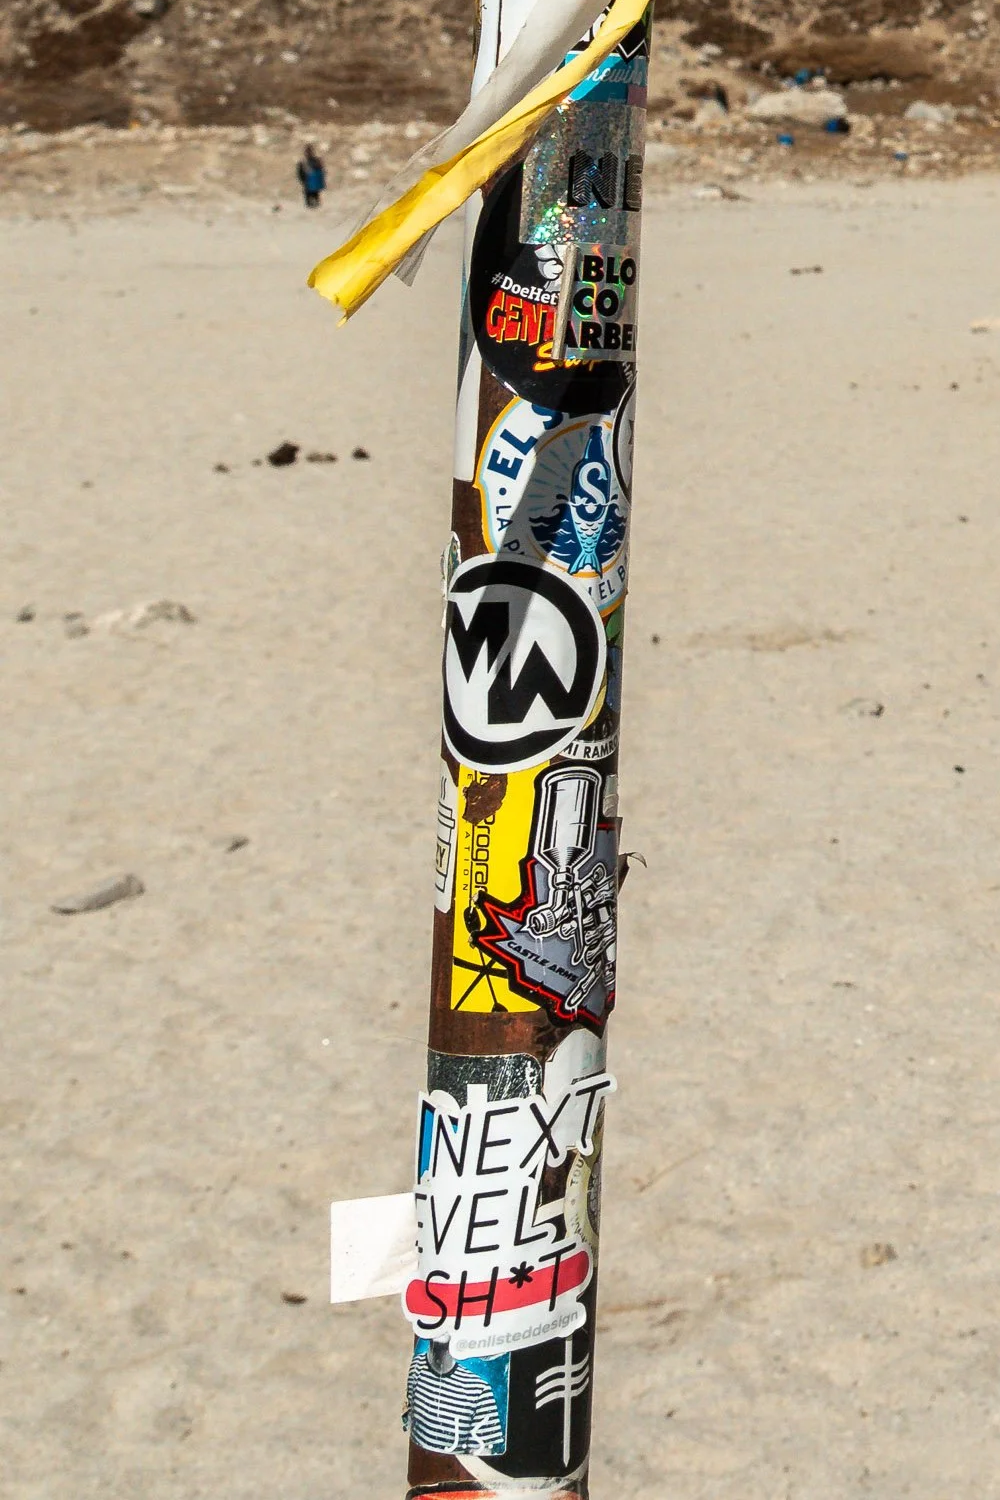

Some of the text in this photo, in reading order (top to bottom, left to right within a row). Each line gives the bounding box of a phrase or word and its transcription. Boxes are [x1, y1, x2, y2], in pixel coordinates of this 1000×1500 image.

[491, 271, 560, 306] #DoeHet
[507, 941, 579, 983] CASTLE ARMS
[432, 1080, 611, 1178] NEXT
[456, 1311, 579, 1351] @enlisteddesign
